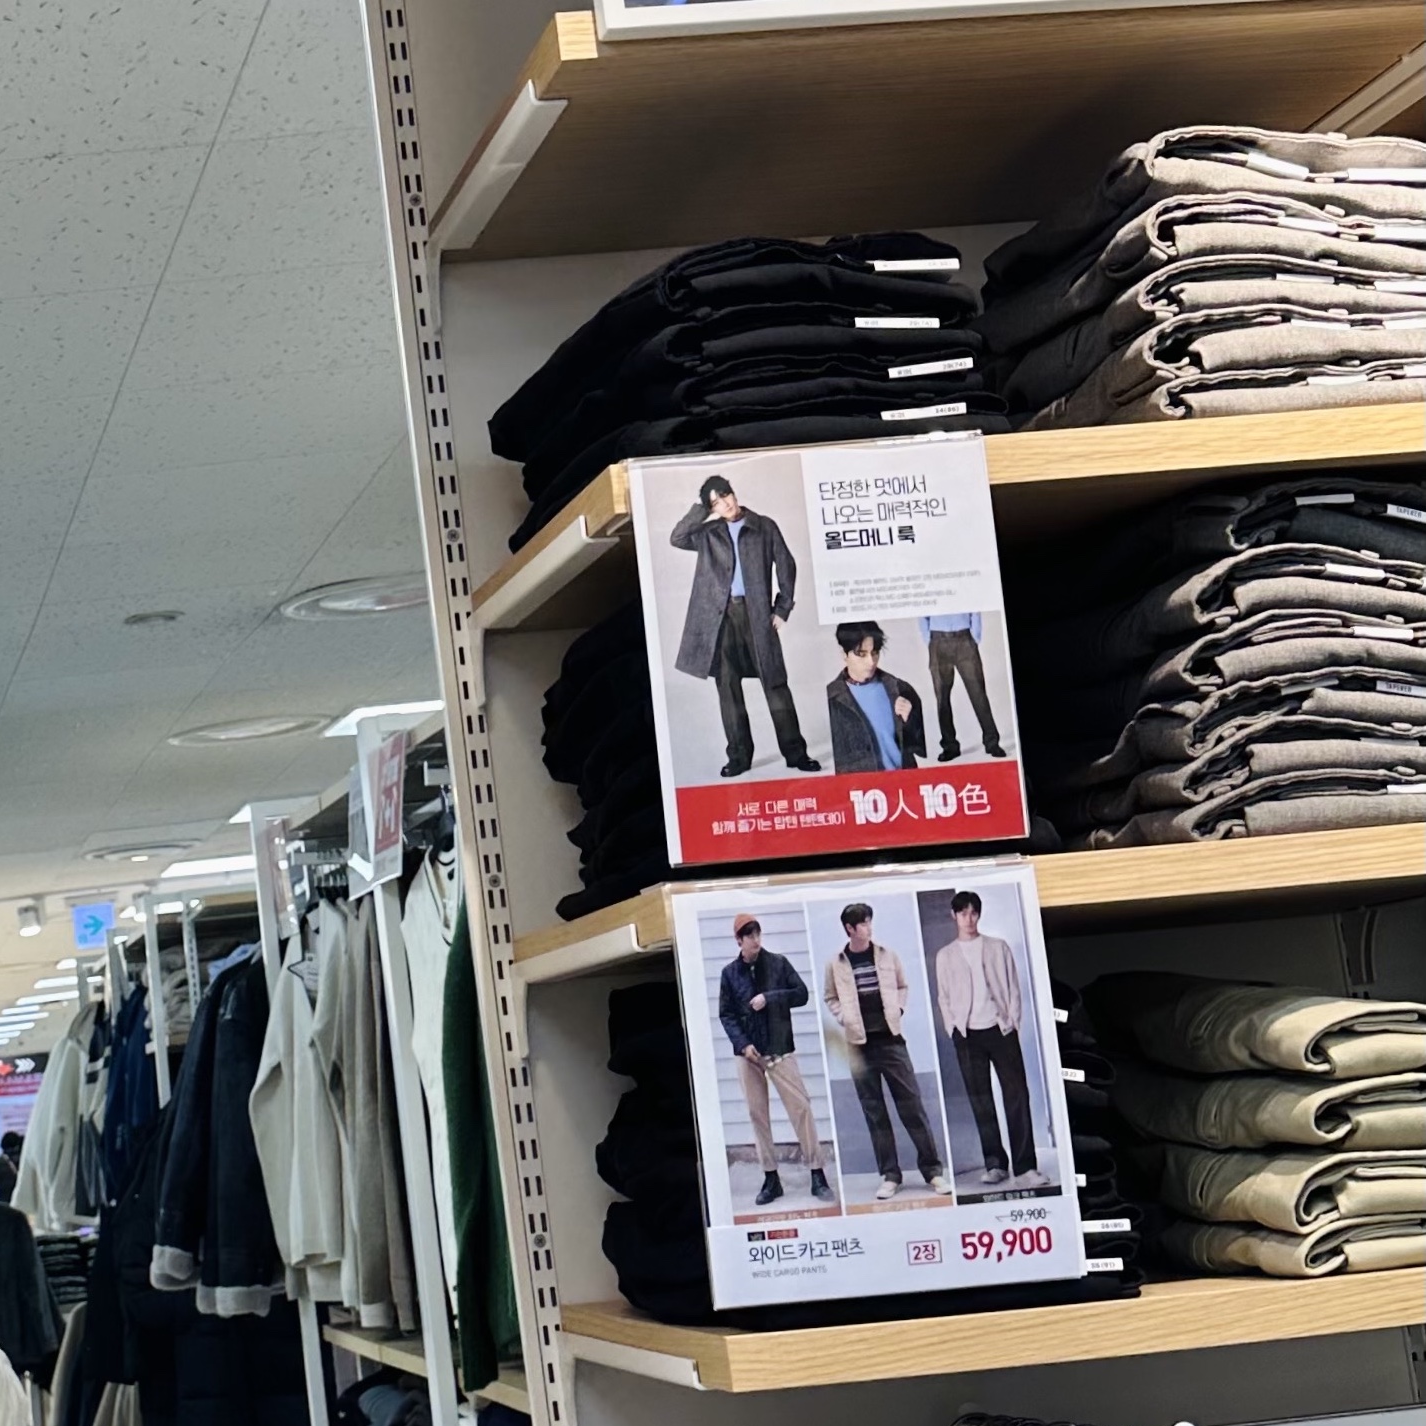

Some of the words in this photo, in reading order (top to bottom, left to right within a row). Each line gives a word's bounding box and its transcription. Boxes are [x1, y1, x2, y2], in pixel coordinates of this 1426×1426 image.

[818, 478, 871, 501] 단정한
[874, 474, 927, 497] 멋에서
[821, 503, 874, 526] 나오는
[877, 497, 948, 522] 매력적인
[824, 526, 894, 550] 올드머니
[897, 525, 916, 544] 룩
[737, 802, 761, 817] 서로
[765, 800, 789, 815] 다른
[793, 797, 817, 812] 매력
[1010, 1207, 1047, 1223] 59,900
[748, 1244, 798, 1265] 와이드
[798, 1241, 831, 1260] 카고
[831, 1237, 865, 1258] 팬츠
[912, 1244, 937, 1262] 2장
[960, 1226, 1053, 1263] 59,900
